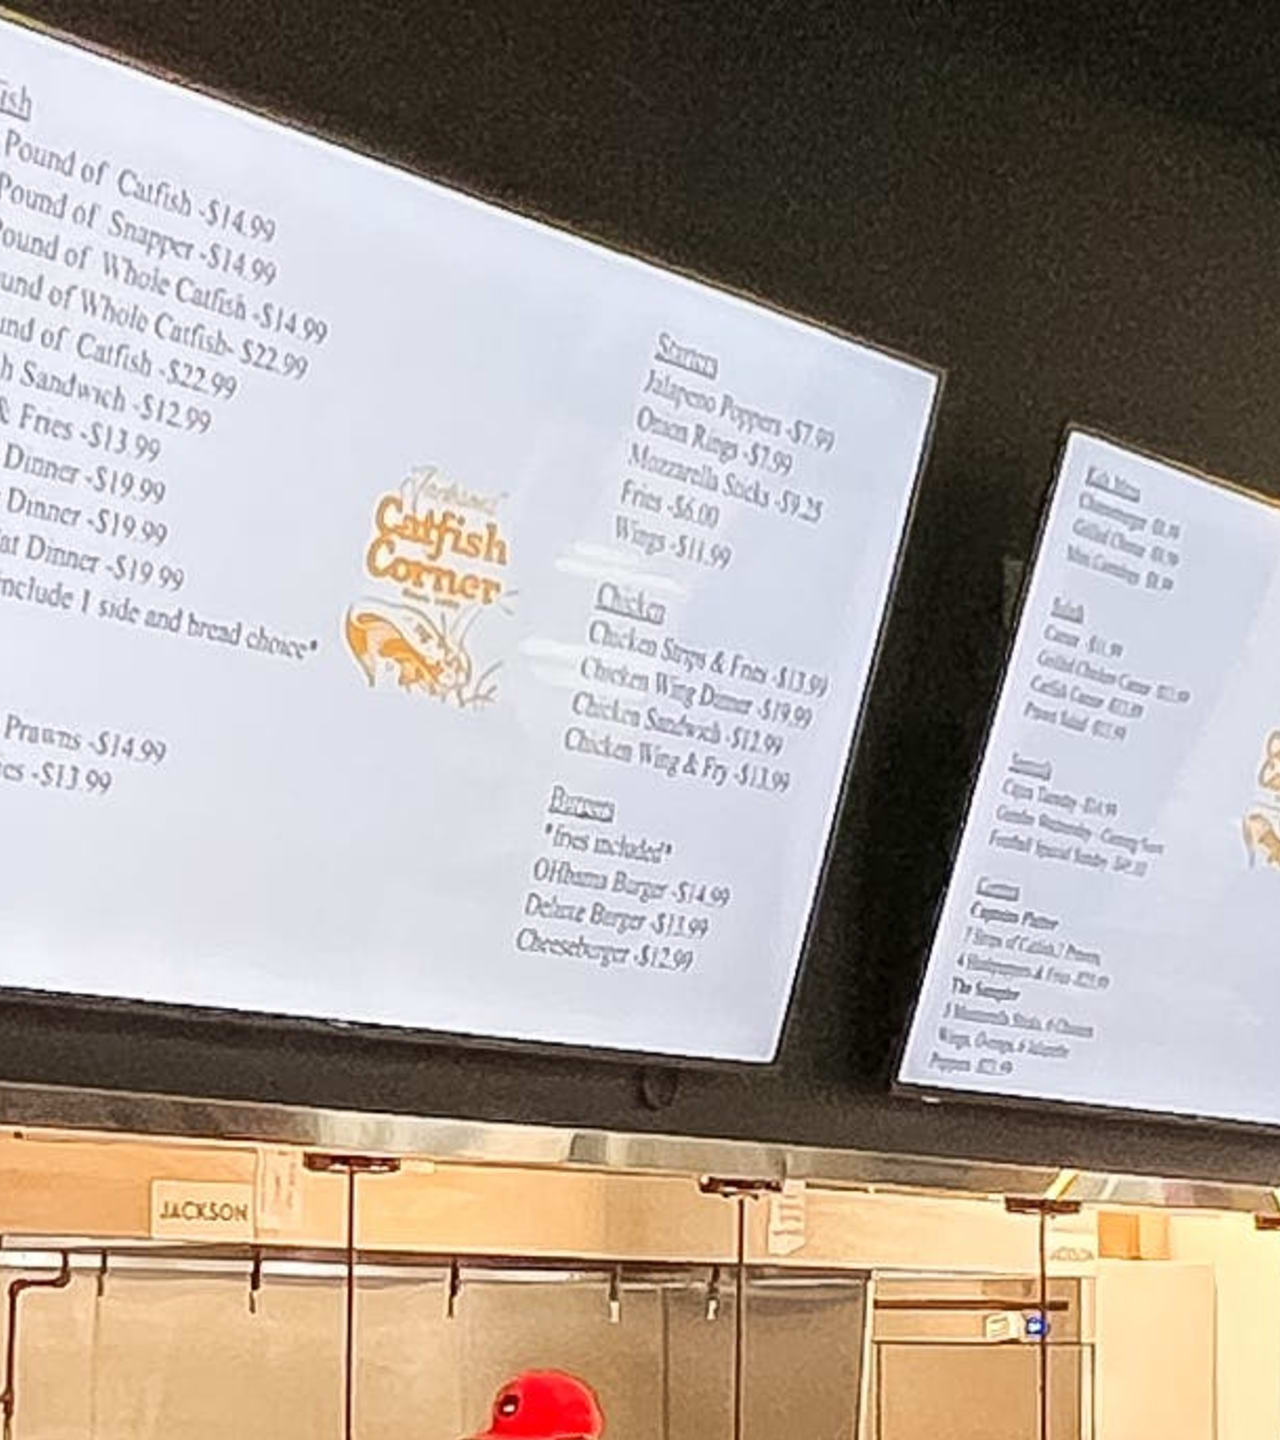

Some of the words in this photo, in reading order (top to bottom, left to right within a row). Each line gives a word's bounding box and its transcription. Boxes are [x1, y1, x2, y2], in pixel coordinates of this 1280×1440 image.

[4, 128, 75, 176] Pound
[80, 160, 110, 185] of
[117, 168, 191, 216] Catfish
[71, 202, 100, 228] of
[107, 209, 194, 260] Snapper
[47, 284, 78, 310] of
[81, 288, 148, 333] Whole
[63, 245, 92, 269] of
[103, 250, 170, 296] Whole
[175, 276, 245, 320] Catfish
[40, 325, 69, 351] of
[76, 332, 151, 377] Catfish
[19, 359, 125, 412] Sandwich
[18, 402, 72, 440] Fries
[3, 442, 80, 484] Dinner
[6, 486, 81, 526] Dinner
[376, 495, 508, 566] Catfish
[25, 533, 100, 573] Dinner
[367, 537, 502, 604] Corner
[81, 588, 90, 613] 1
[98, 597, 140, 623] side
[143, 607, 183, 633] and
[187, 612, 242, 645] bread
[4, 713, 81, 750] Prawns
[159, 1200, 248, 1221] JACKSON
